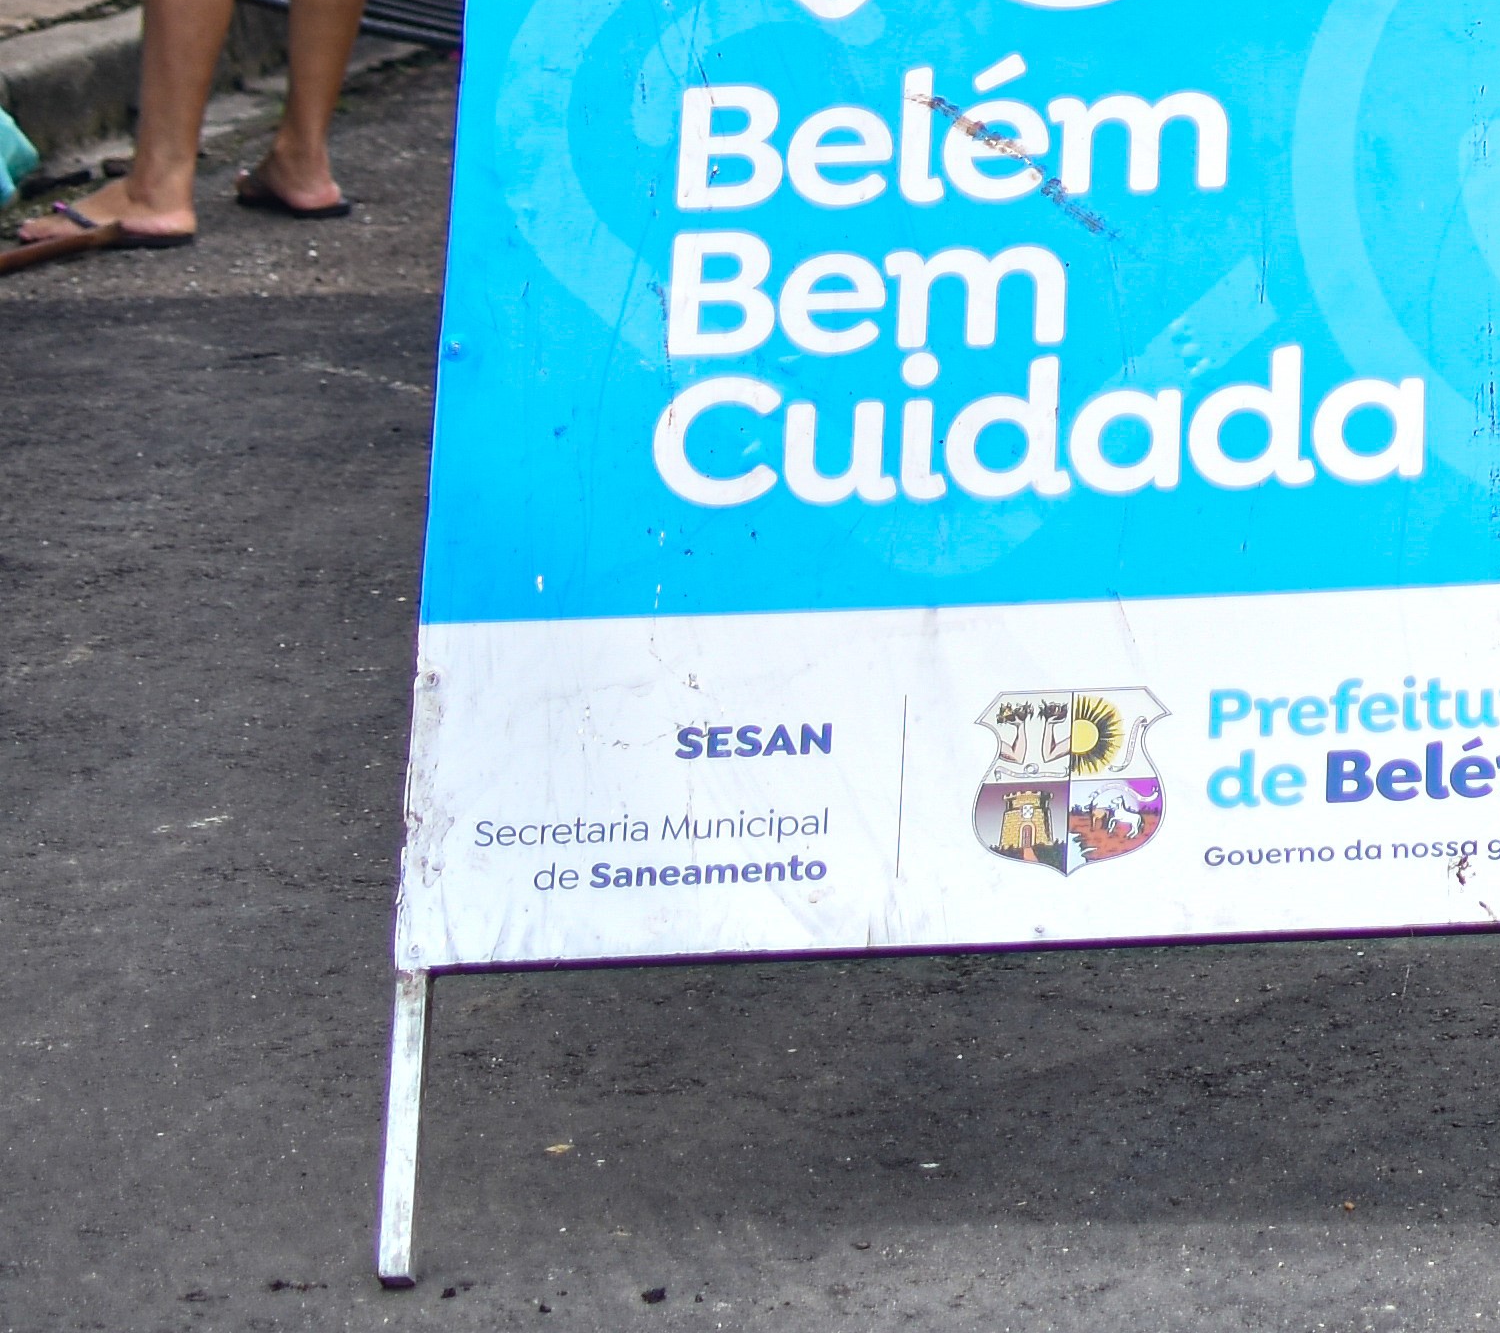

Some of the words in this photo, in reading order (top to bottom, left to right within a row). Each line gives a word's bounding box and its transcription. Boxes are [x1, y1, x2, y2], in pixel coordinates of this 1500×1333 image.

[675, 54, 1229, 210] Belém
[667, 231, 1067, 356] Bem
[653, 344, 1425, 506] Cuidada
[675, 722, 833, 760] SESAN
[1206, 748, 1307, 808] de
[474, 813, 649, 847] Secretaria
[660, 807, 830, 844] Municipal
[1204, 845, 1335, 866] Governo
[1343, 839, 1382, 861] da
[1391, 838, 1478, 860] nossa
[533, 862, 579, 891] de
[589, 854, 828, 889] Saneamento
